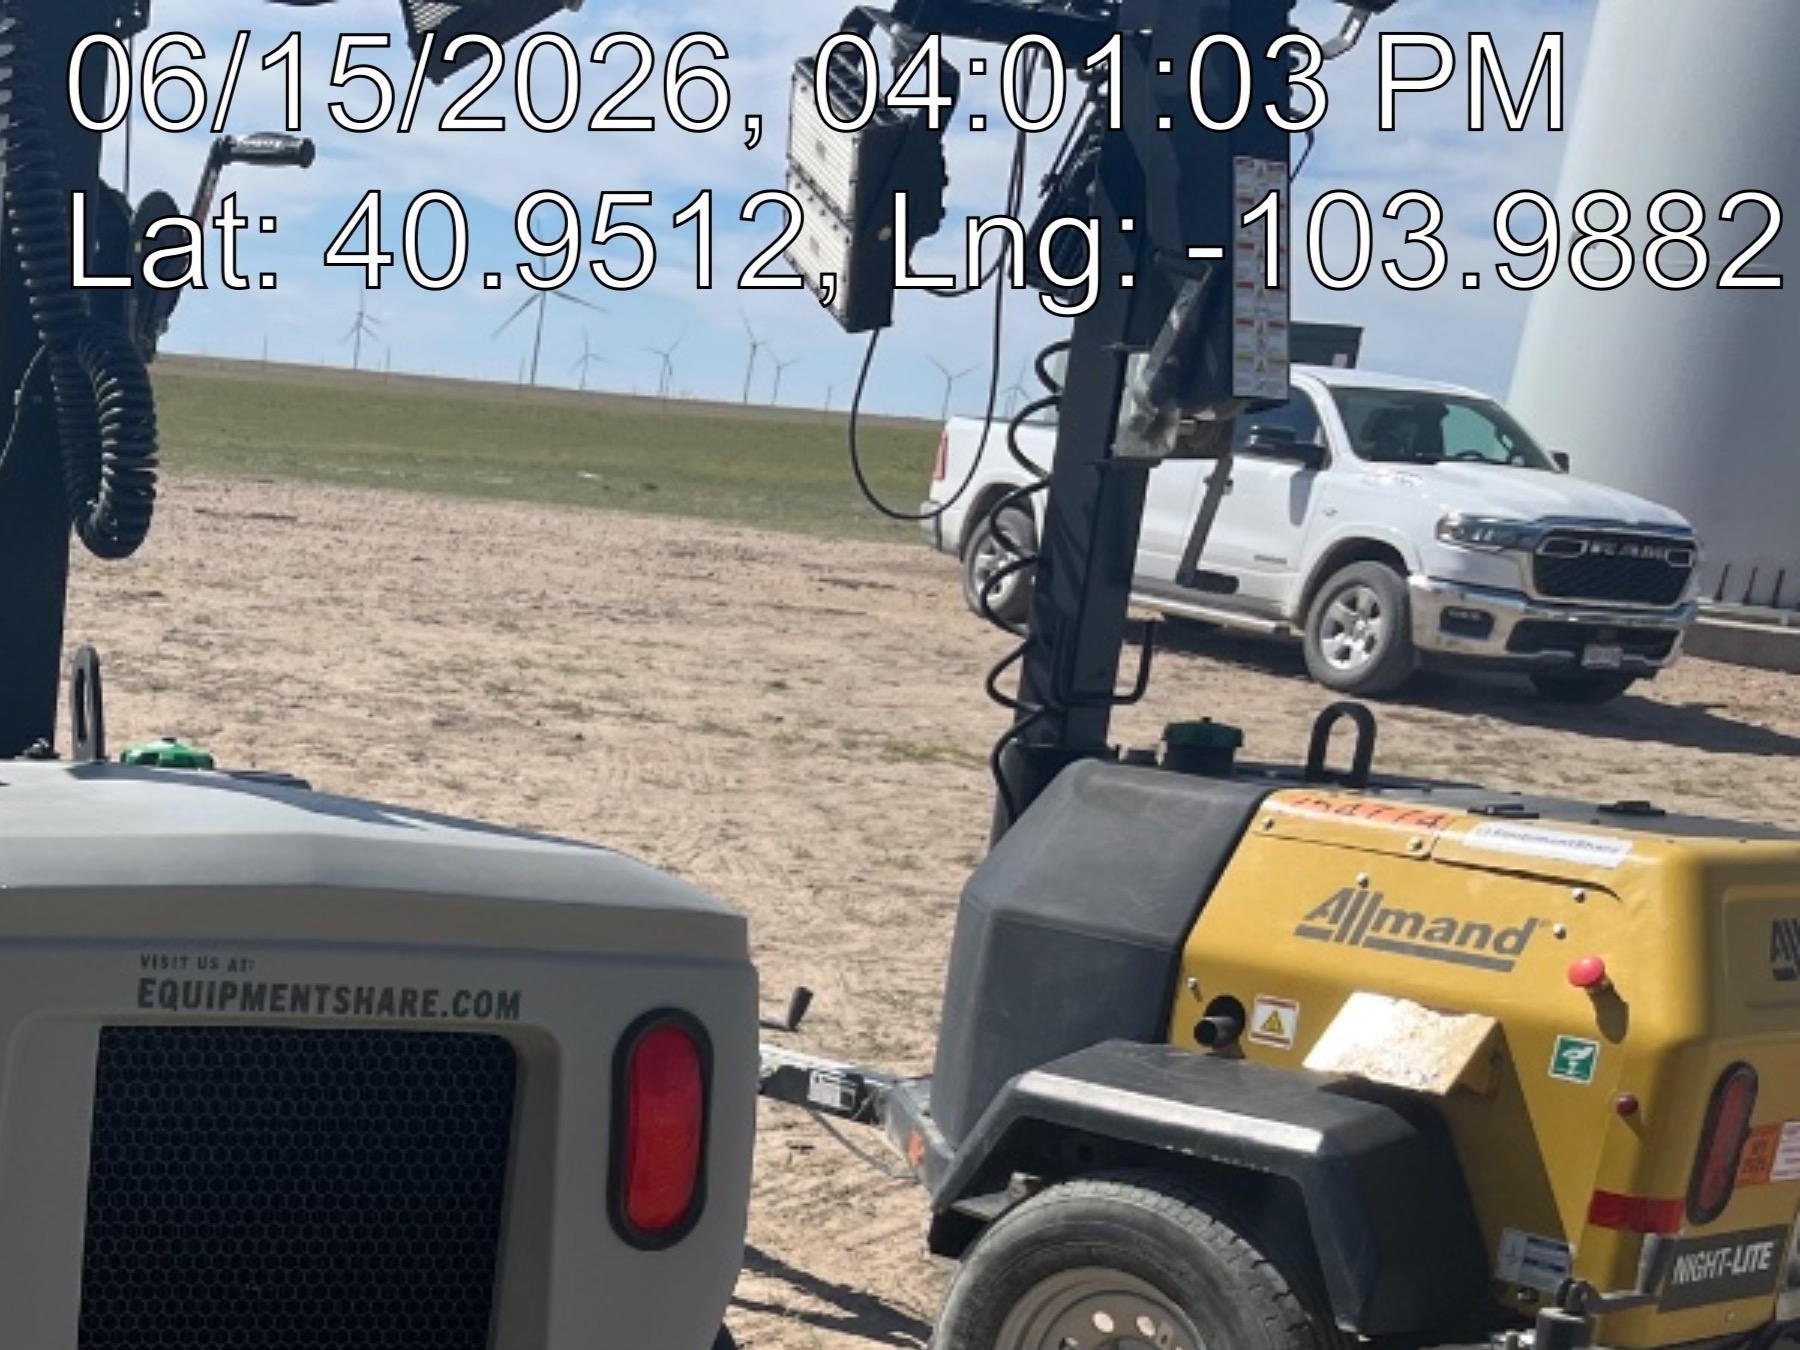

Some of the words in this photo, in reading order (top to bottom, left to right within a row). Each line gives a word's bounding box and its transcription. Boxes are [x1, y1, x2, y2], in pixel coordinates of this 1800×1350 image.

[1300, 886, 1540, 957] Allmand
[140, 952, 189, 970] VISIT
[198, 955, 220, 971] US
[137, 976, 523, 1021] EQUIPMENTSHARE.COM
[1671, 1240, 1775, 1286] NIGHT-LITE
